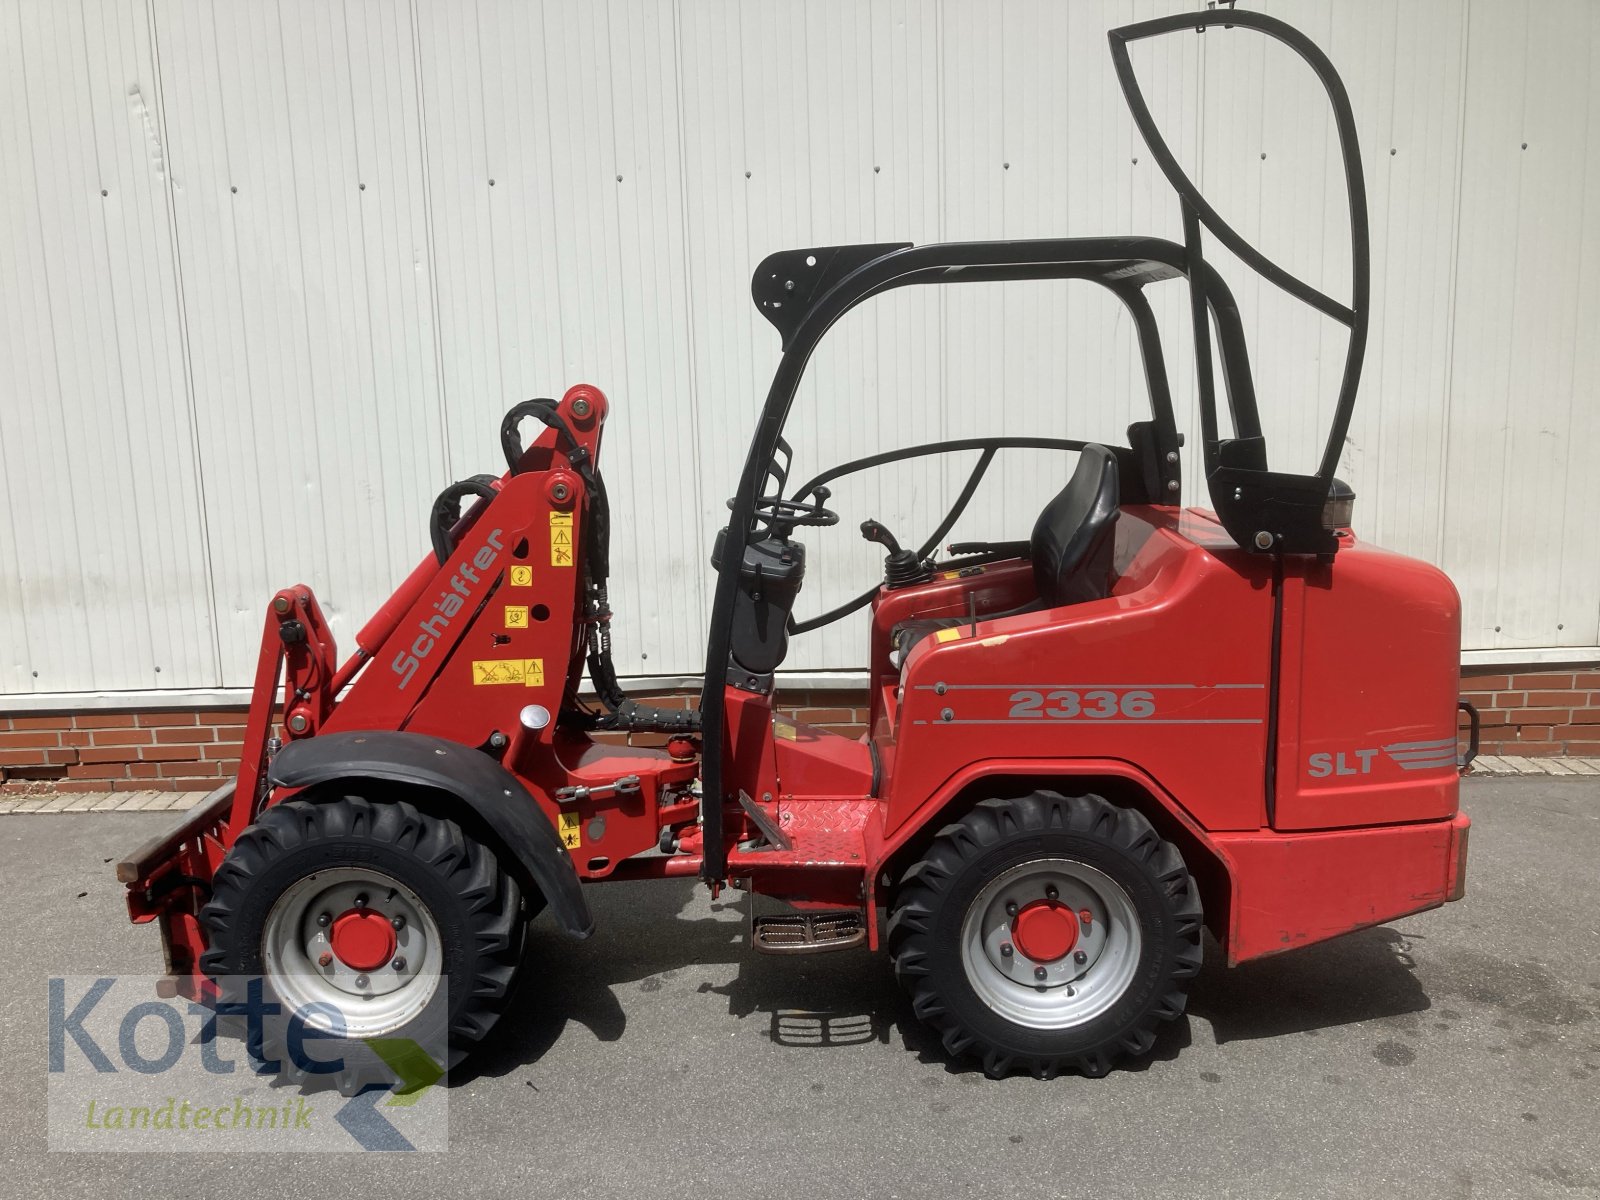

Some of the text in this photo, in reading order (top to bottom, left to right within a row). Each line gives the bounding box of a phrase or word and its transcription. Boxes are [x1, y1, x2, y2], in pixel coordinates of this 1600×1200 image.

[391, 528, 504, 690] Schäffer
[1008, 690, 1156, 718] 2336
[1308, 748, 1379, 778] SLT
